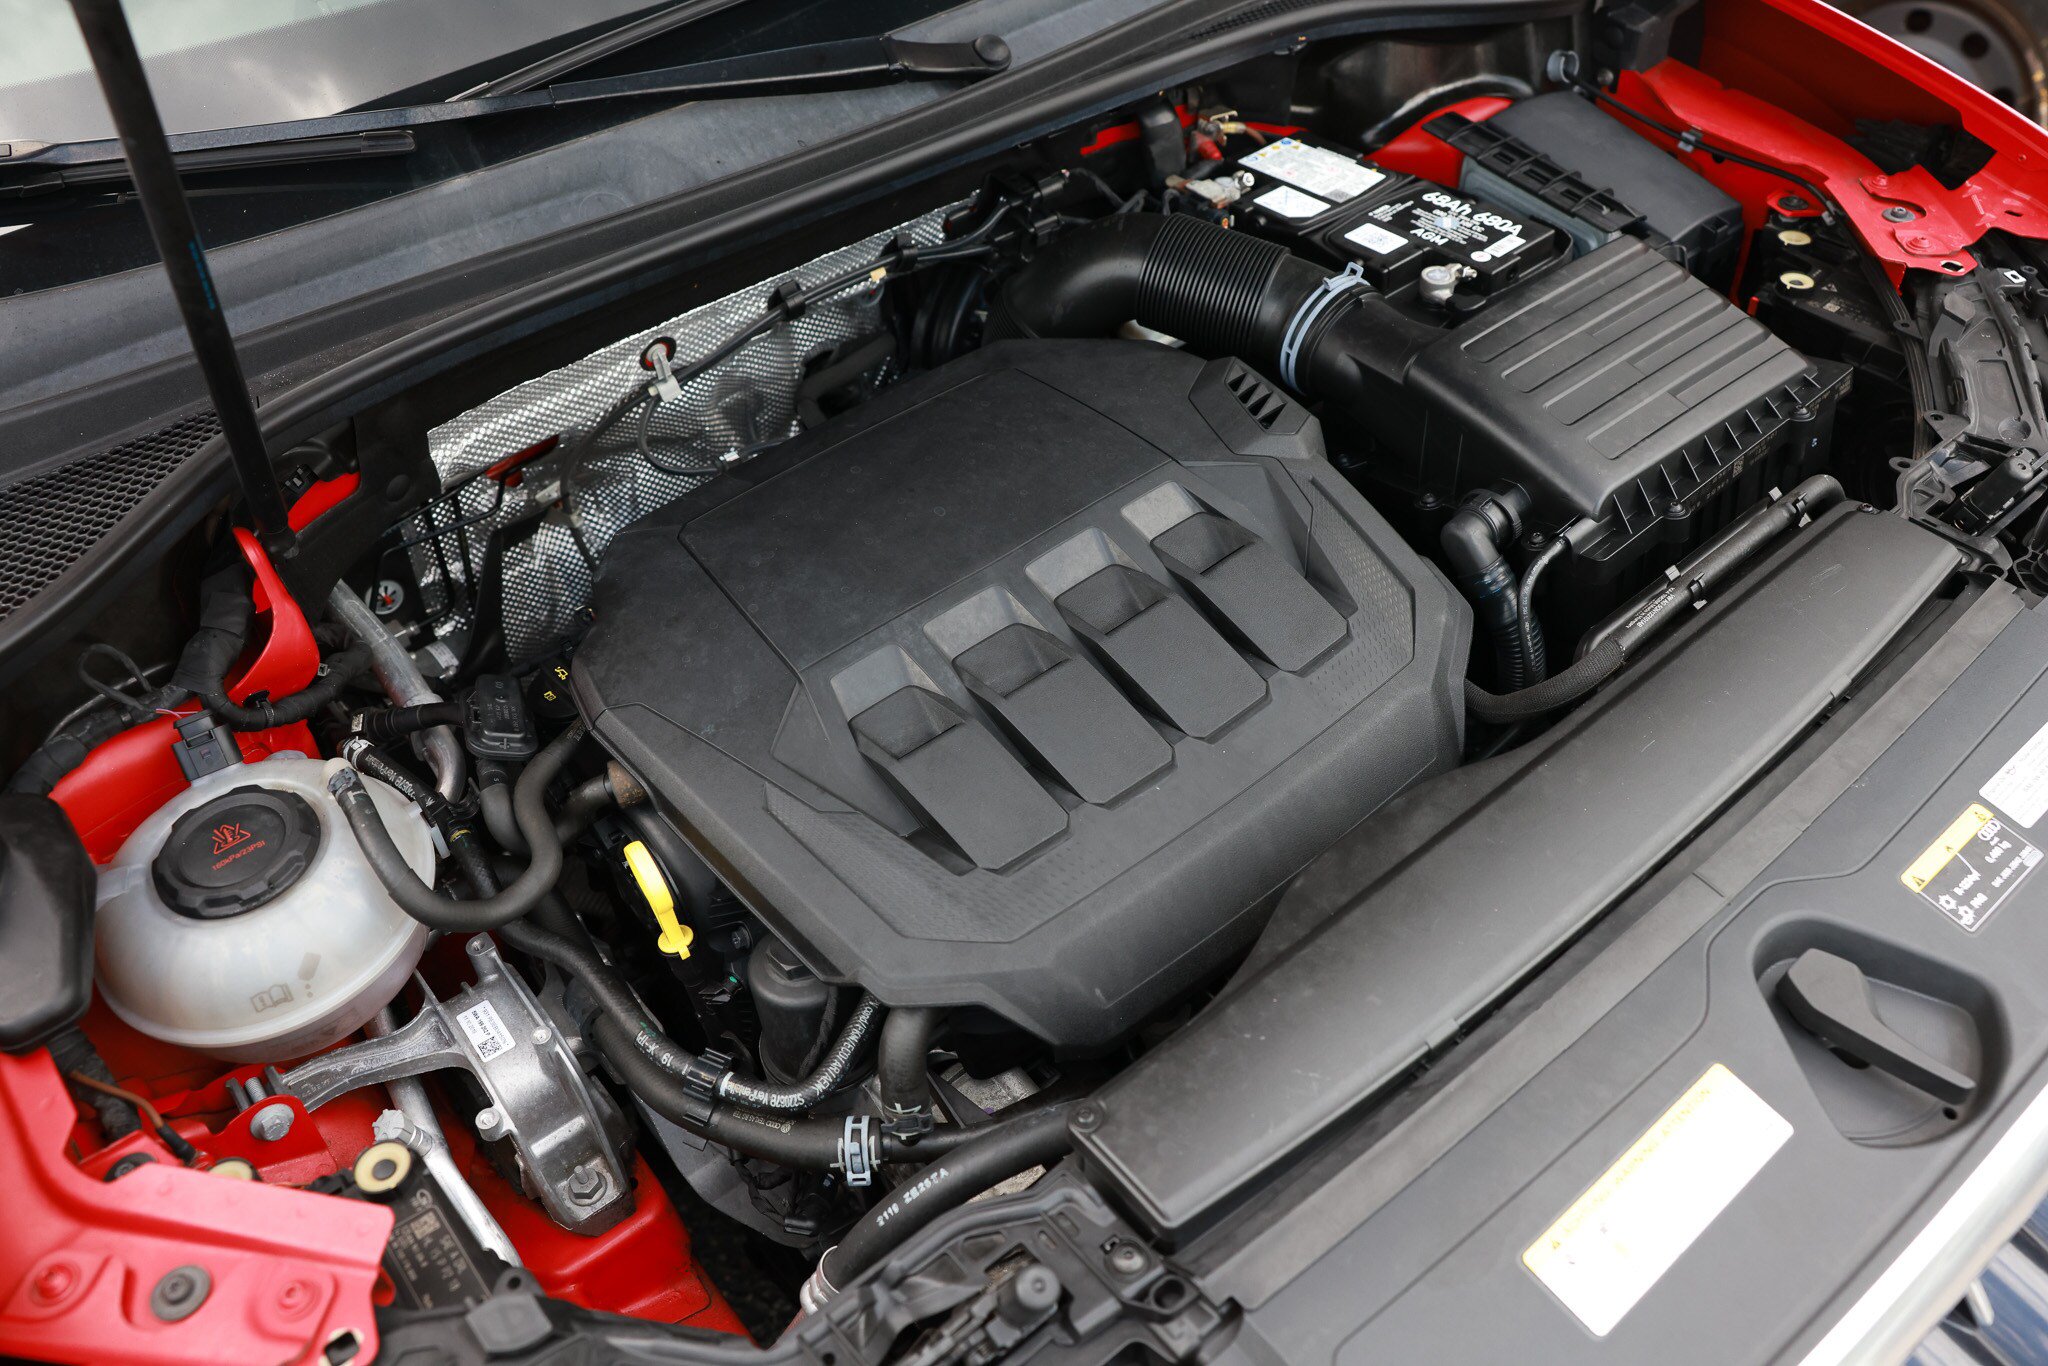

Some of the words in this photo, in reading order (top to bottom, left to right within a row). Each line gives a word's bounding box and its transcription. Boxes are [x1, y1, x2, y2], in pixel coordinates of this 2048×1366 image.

[1422, 192, 1472, 216] 68Ah
[1473, 212, 1522, 236] 680A
[1410, 228, 1449, 246] AGM
